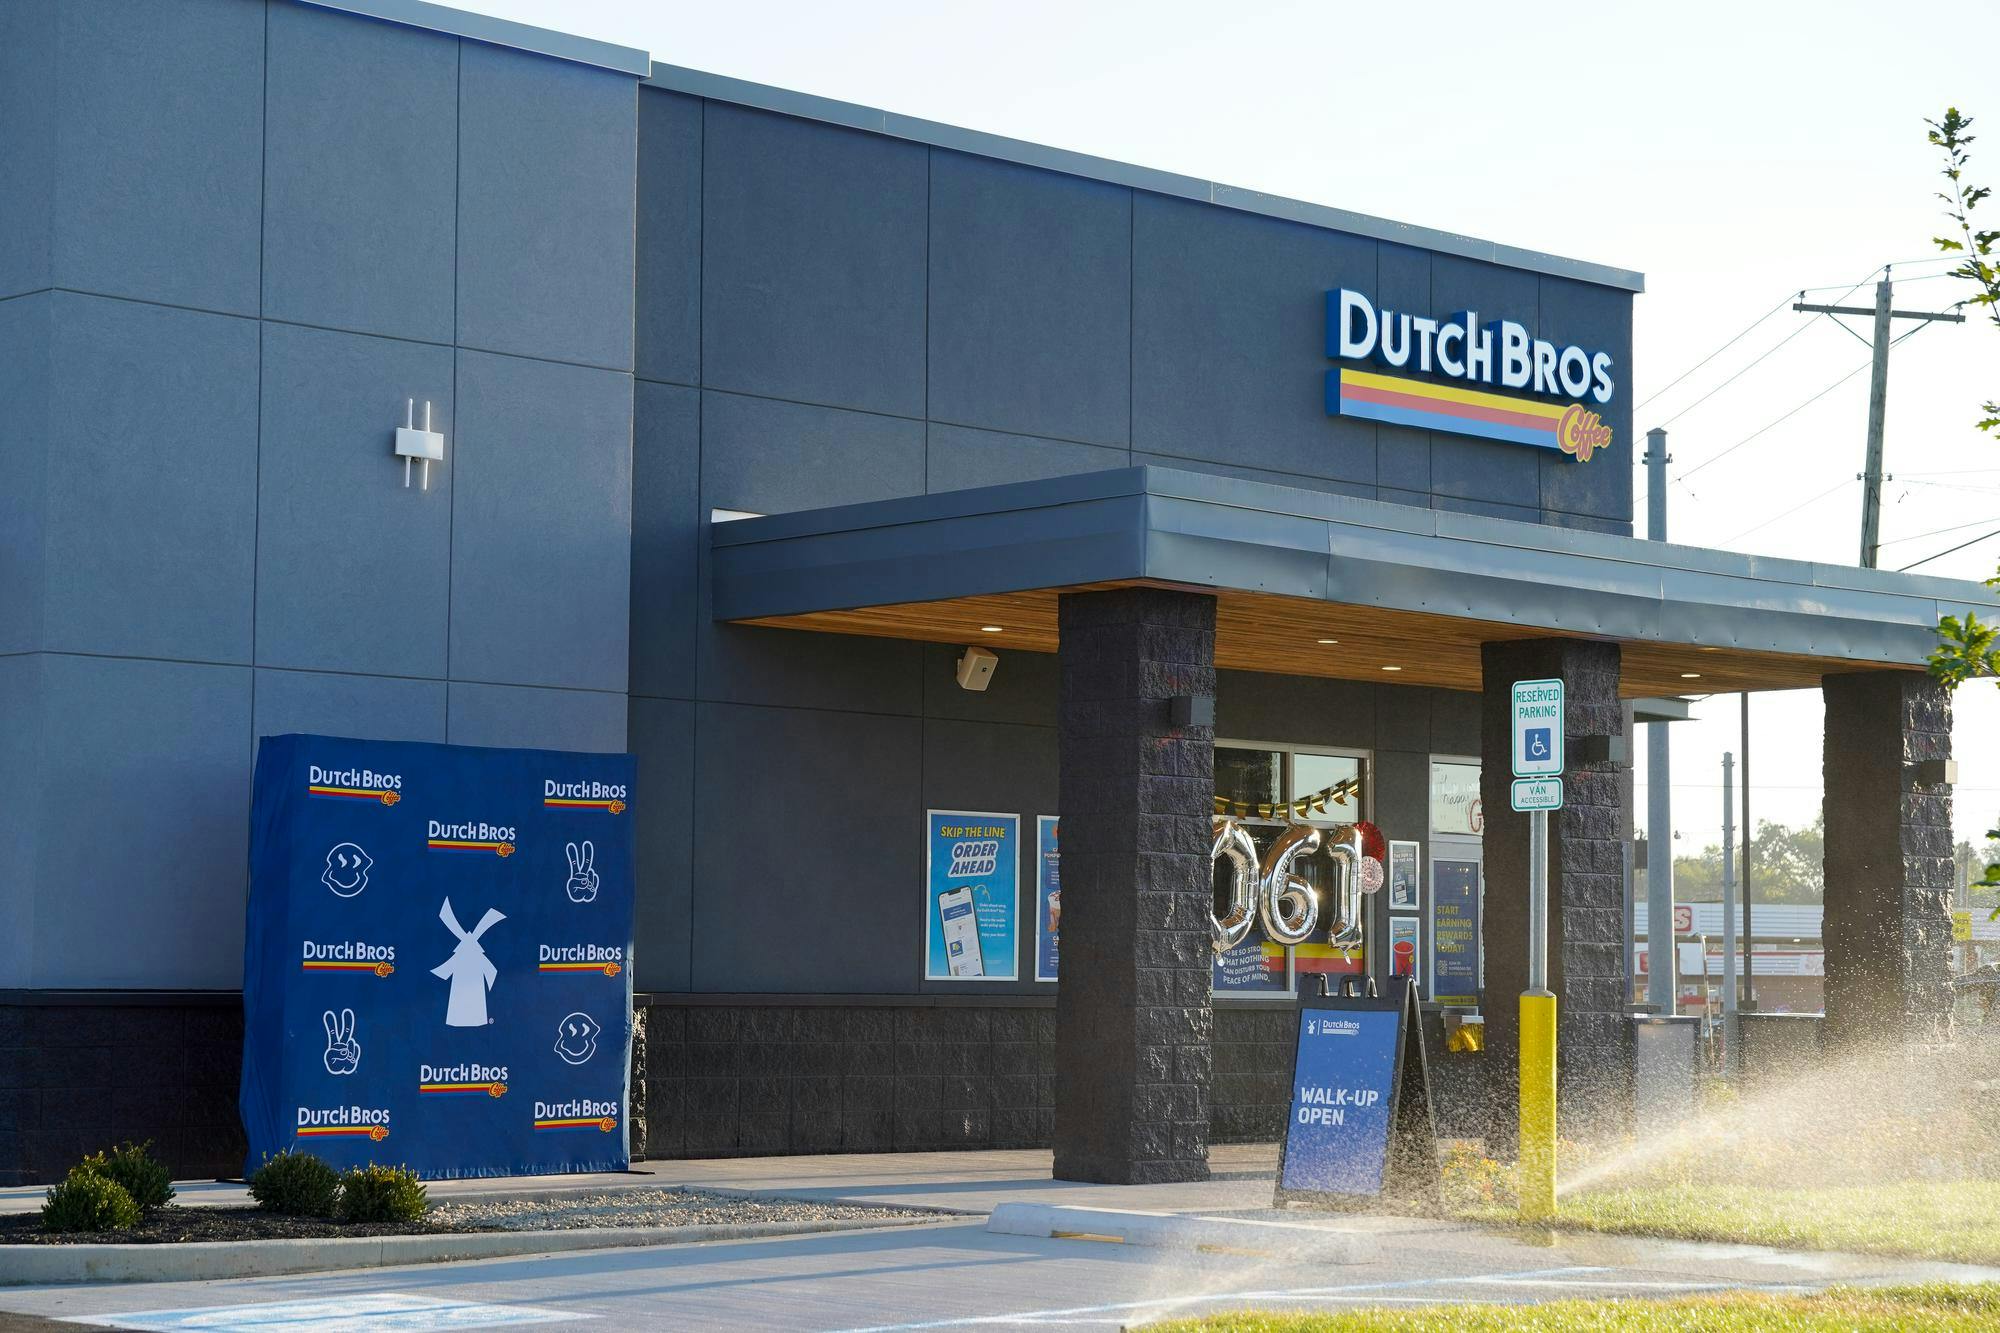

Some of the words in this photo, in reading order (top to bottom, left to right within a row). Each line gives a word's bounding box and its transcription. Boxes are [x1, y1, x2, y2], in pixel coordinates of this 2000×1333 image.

[1557, 403, 1612, 463] Coffee
[1516, 689, 1560, 703] RESERVED
[1519, 705, 1557, 719] PARKING
[1529, 786, 1547, 795] VAN
[1520, 796, 1555, 804] ACCESSIBLE
[941, 826, 963, 838] SKIP
[965, 826, 982, 837] THE
[984, 826, 1006, 838] LINE
[953, 843, 998, 859] ORDER
[950, 860, 995, 875] AHEAD
[1437, 905, 1459, 915] START
[1223, 956, 1238, 966] THAT
[1239, 954, 1270, 965] NOTHING
[1223, 975, 1241, 984] PEACE
[1242, 975, 1250, 983] OF
[1301, 1086, 1379, 1107] WALK-UP
[1298, 1107, 1345, 1126] OPEN
